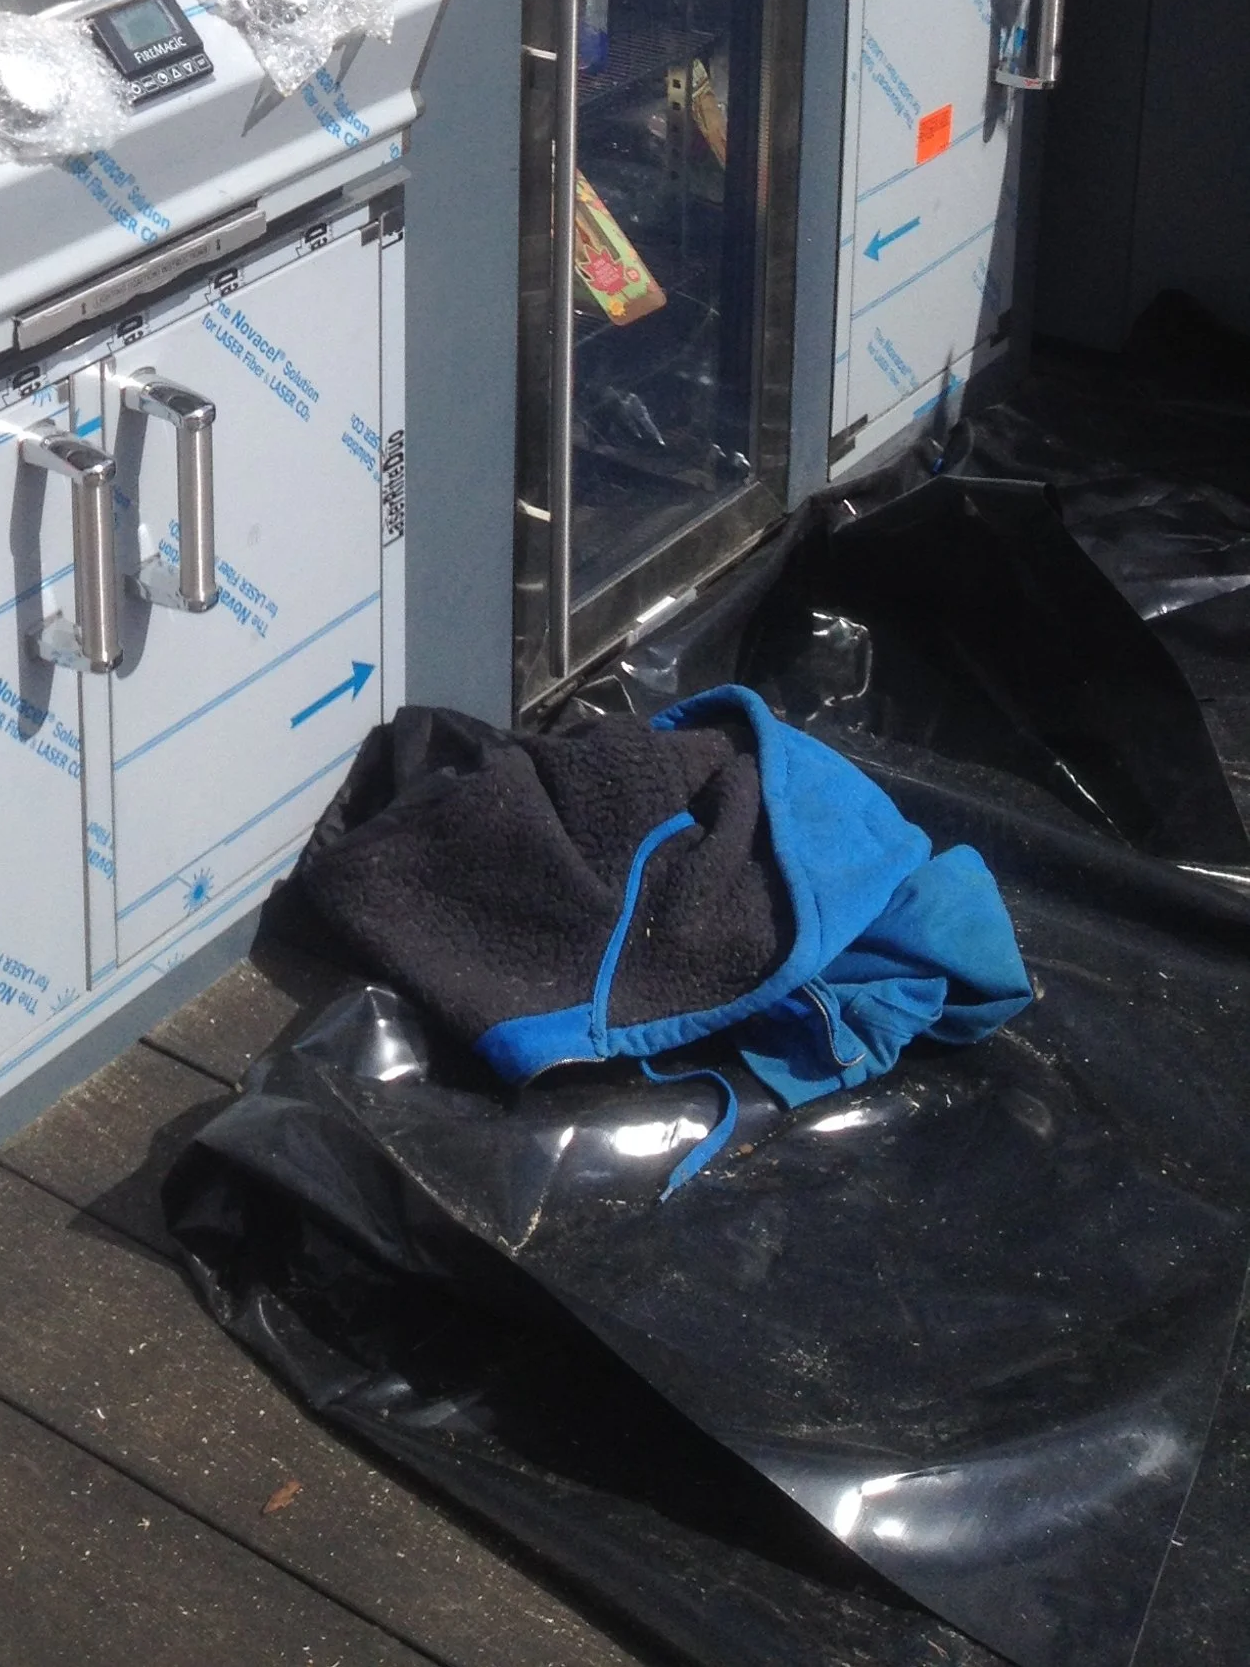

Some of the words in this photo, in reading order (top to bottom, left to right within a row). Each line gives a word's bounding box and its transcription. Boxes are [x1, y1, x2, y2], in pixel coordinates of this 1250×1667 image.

[202, 312, 216, 334] for
[215, 325, 244, 360] LASER
[242, 351, 265, 378] Fiber
[269, 375, 297, 408] LASER
[283, 360, 319, 403] Solution
[239, 577, 267, 609] LASER
[251, 614, 268, 638] The
[36, 739, 68, 770] LASER
[2, 954, 35, 985] LASER
[35, 973, 50, 994] for
[18, 991, 39, 1016] The
